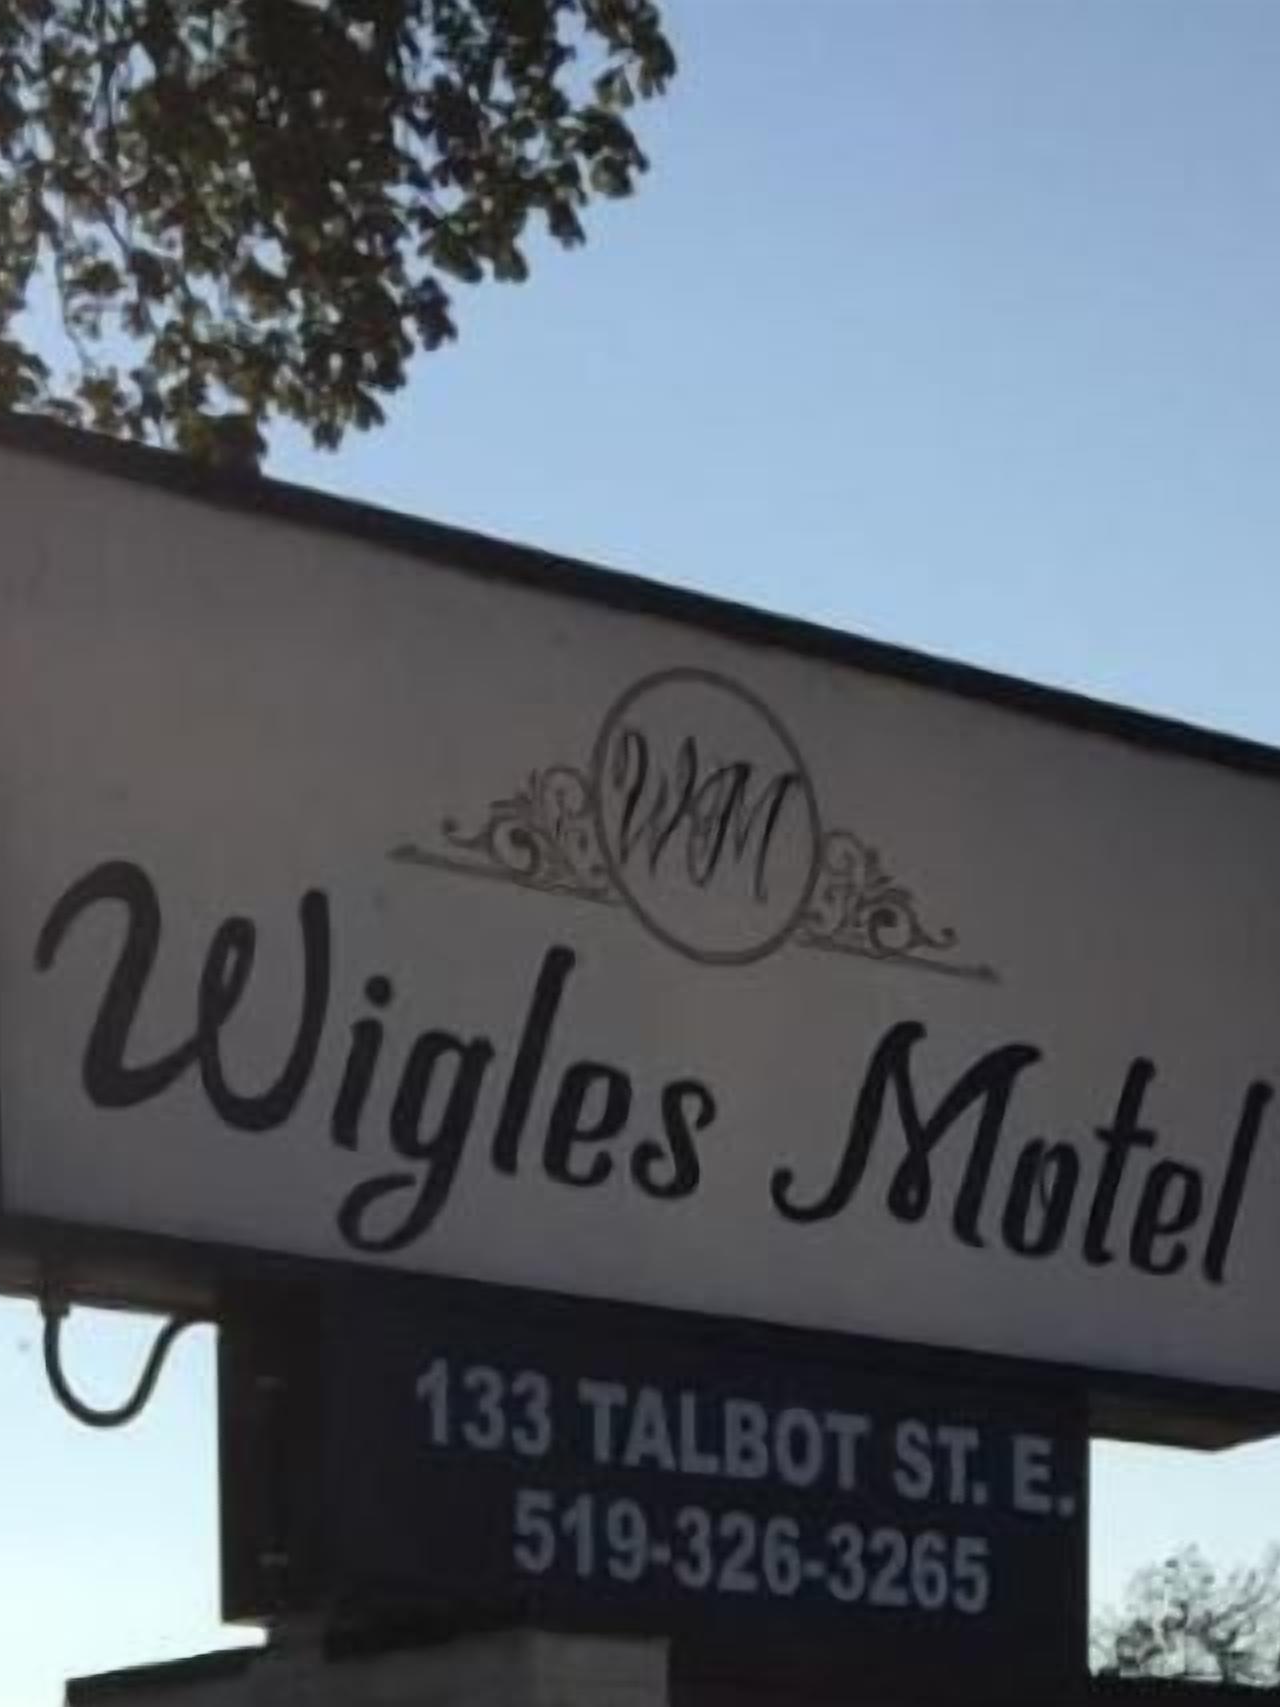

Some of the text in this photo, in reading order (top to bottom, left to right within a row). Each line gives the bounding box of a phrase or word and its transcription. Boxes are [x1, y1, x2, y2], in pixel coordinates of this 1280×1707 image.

[35, 858, 1275, 1286] Wigles Motel
[417, 1356, 1076, 1517] 133 TALBOT ST. E.
[513, 1488, 990, 1613] 519-326-3265
